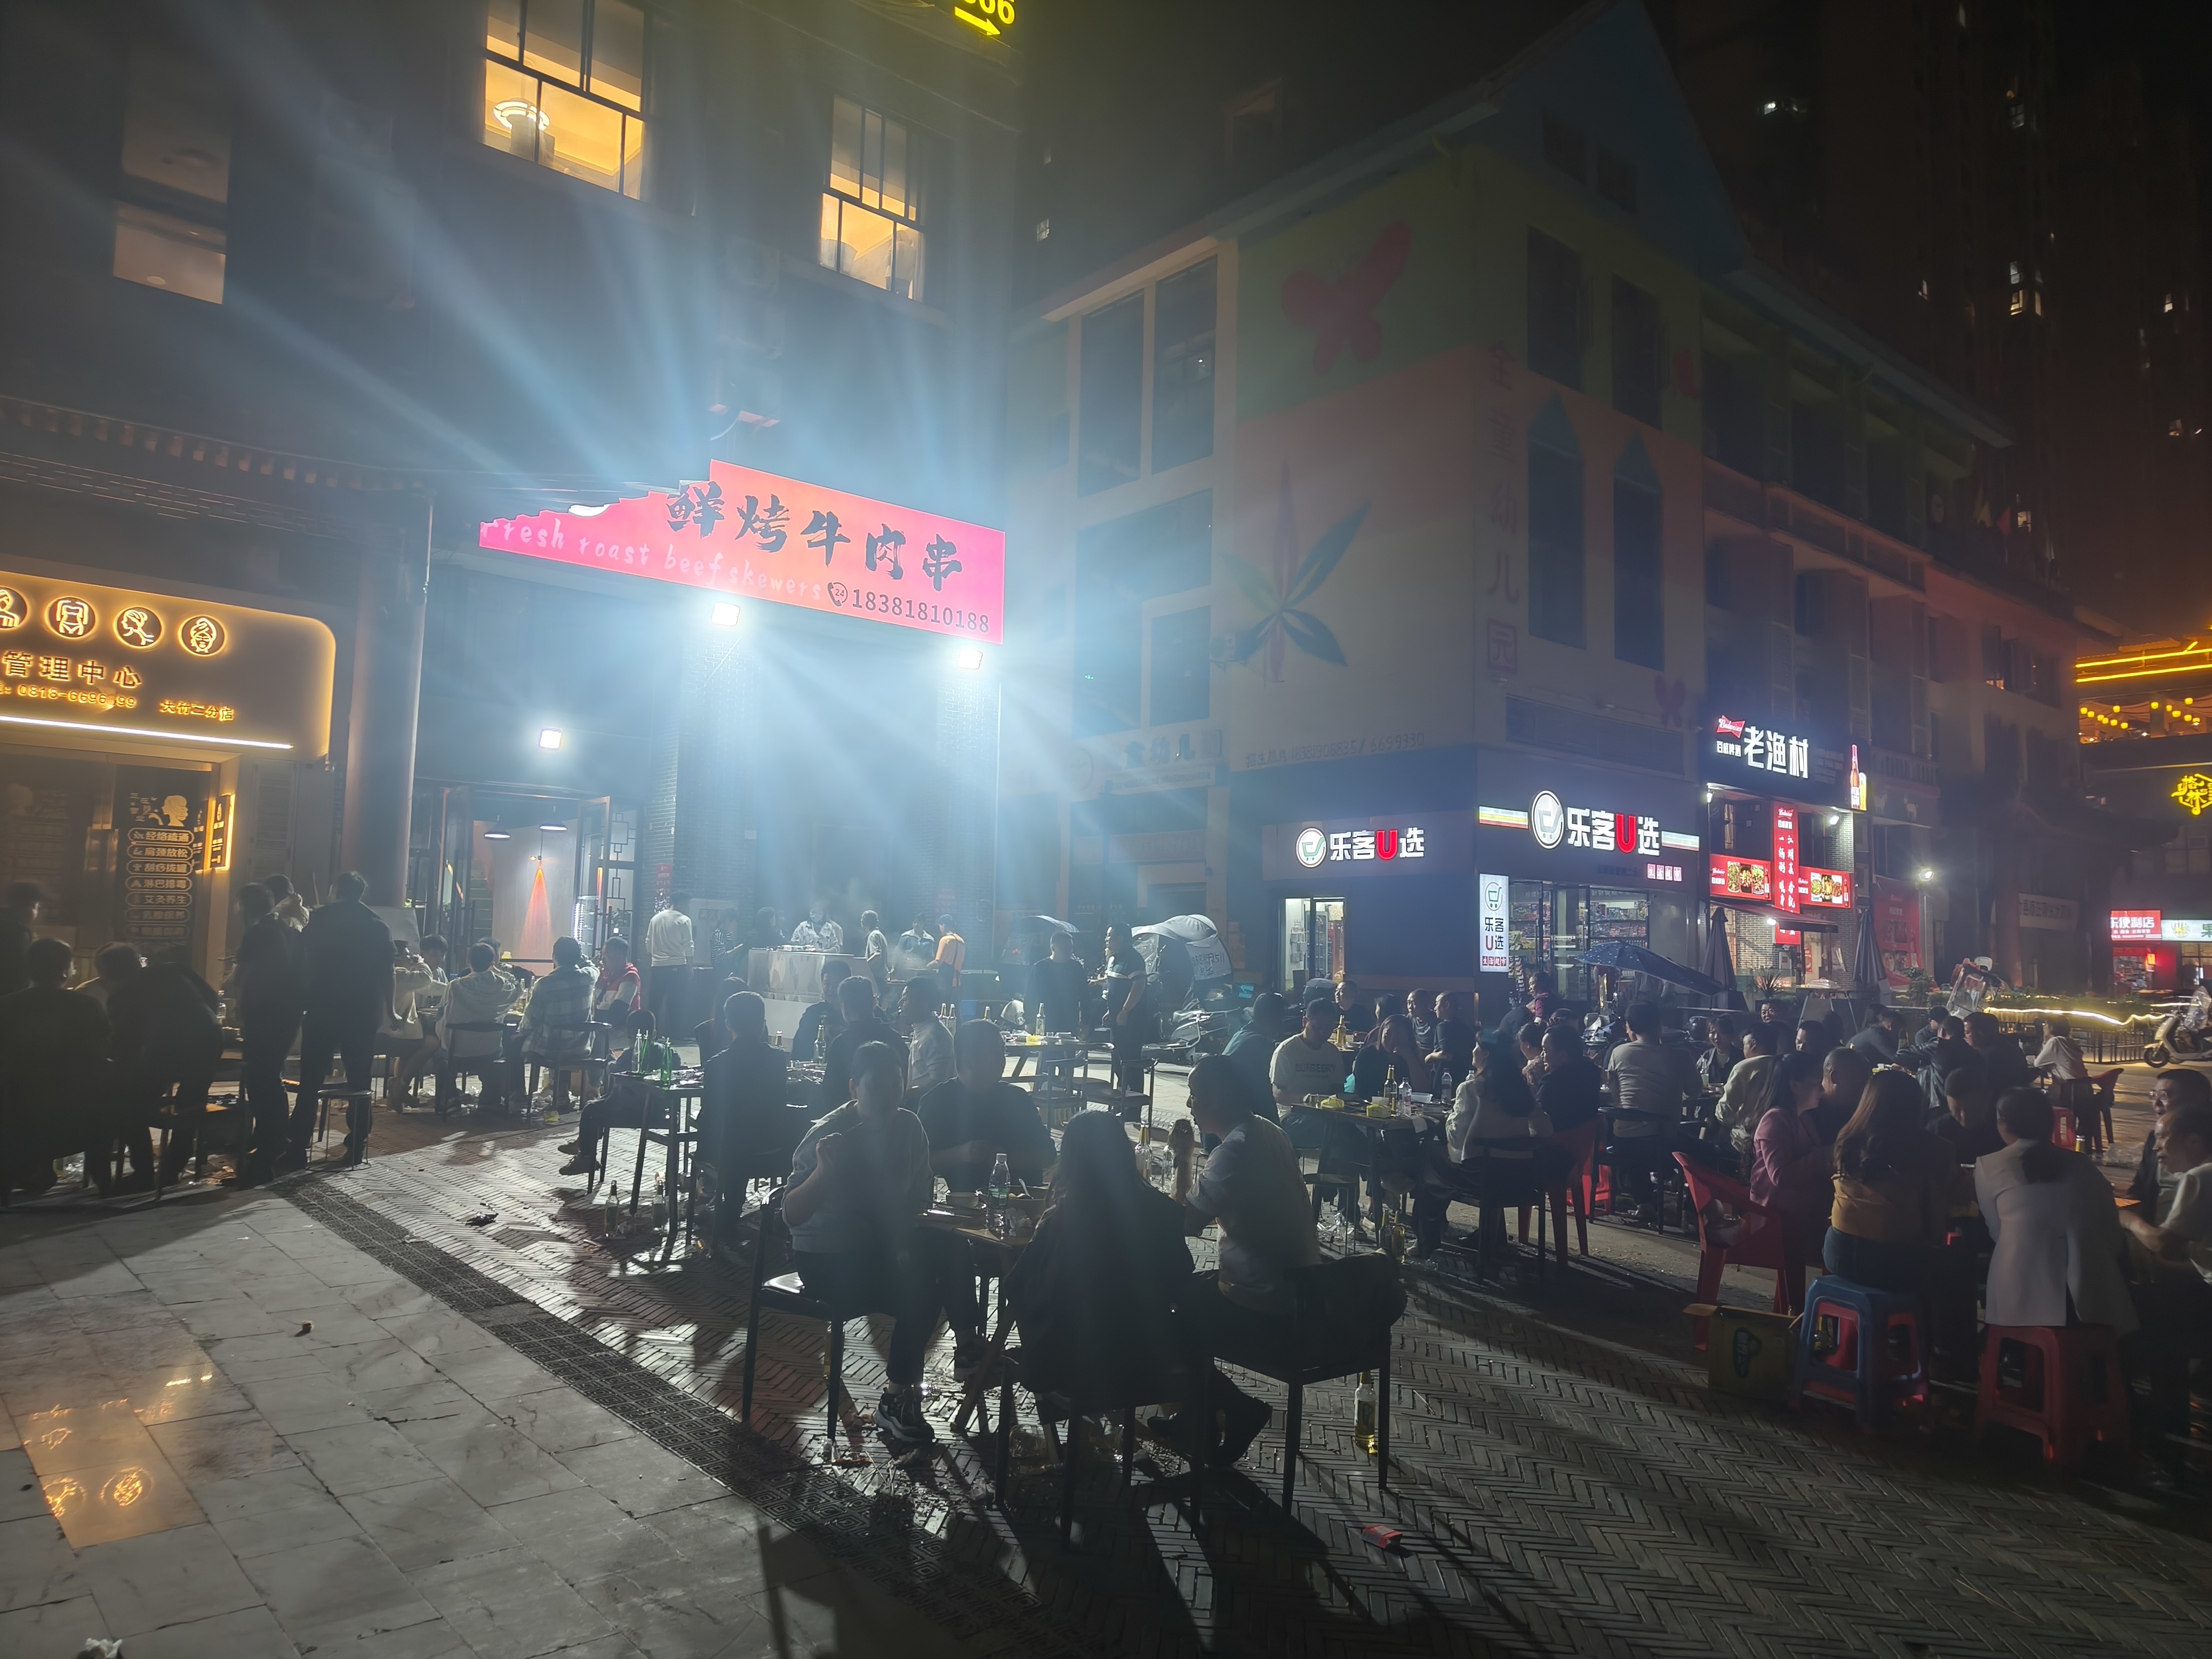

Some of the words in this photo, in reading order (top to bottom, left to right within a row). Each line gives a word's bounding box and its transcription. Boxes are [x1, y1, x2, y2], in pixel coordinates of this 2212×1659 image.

[666, 481, 962, 591] 鲜烤牛肉串
[579, 537, 650, 565] roast
[664, 544, 724, 586] beef
[728, 563, 821, 601] skewers
[852, 589, 989, 633] 18381810188
[2, 650, 143, 689] 管理中心
[1719, 718, 1742, 732] Budweiser
[1744, 726, 1809, 779] 老渔村
[1330, 827, 1425, 860] 乐客U选
[1567, 807, 1660, 856] 乐客U选
[145, 847, 188, 858] 肩颈放松
[1485, 917, 1503, 932] 乐客
[1486, 935, 1503, 950] U选
